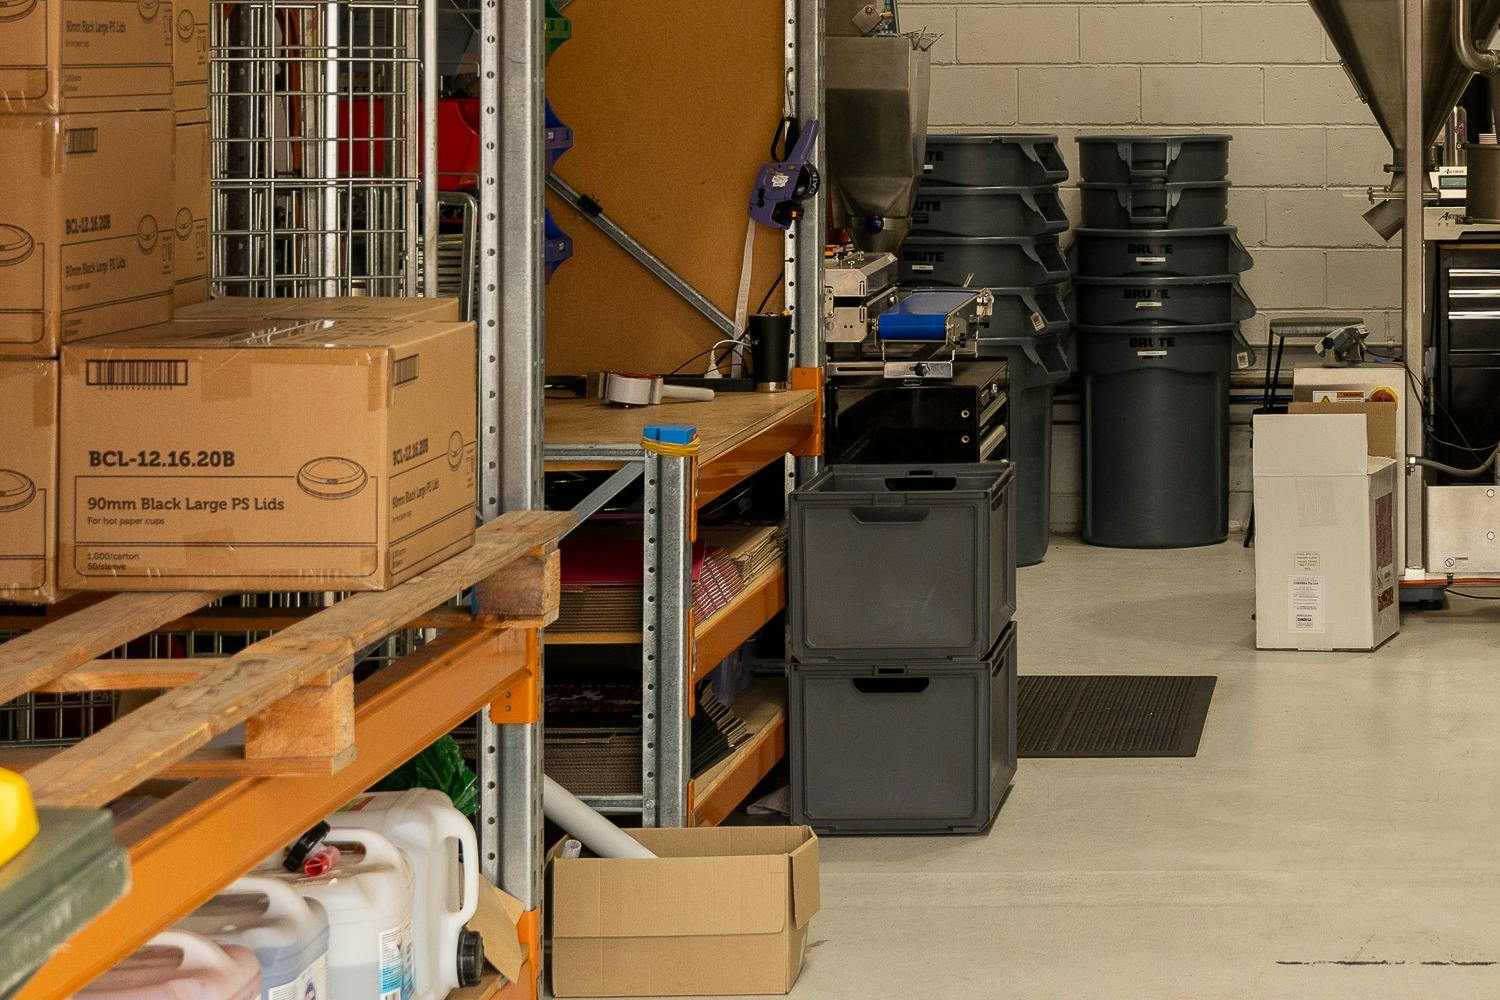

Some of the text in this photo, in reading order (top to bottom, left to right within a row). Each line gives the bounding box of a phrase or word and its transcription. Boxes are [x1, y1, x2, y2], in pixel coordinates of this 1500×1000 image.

[89, 450, 236, 467] BCL-12.16.20B
[88, 497, 285, 513] 90mm Black Large PS Lids
[119, 518, 144, 526] paper
[146, 518, 165, 526] cups
